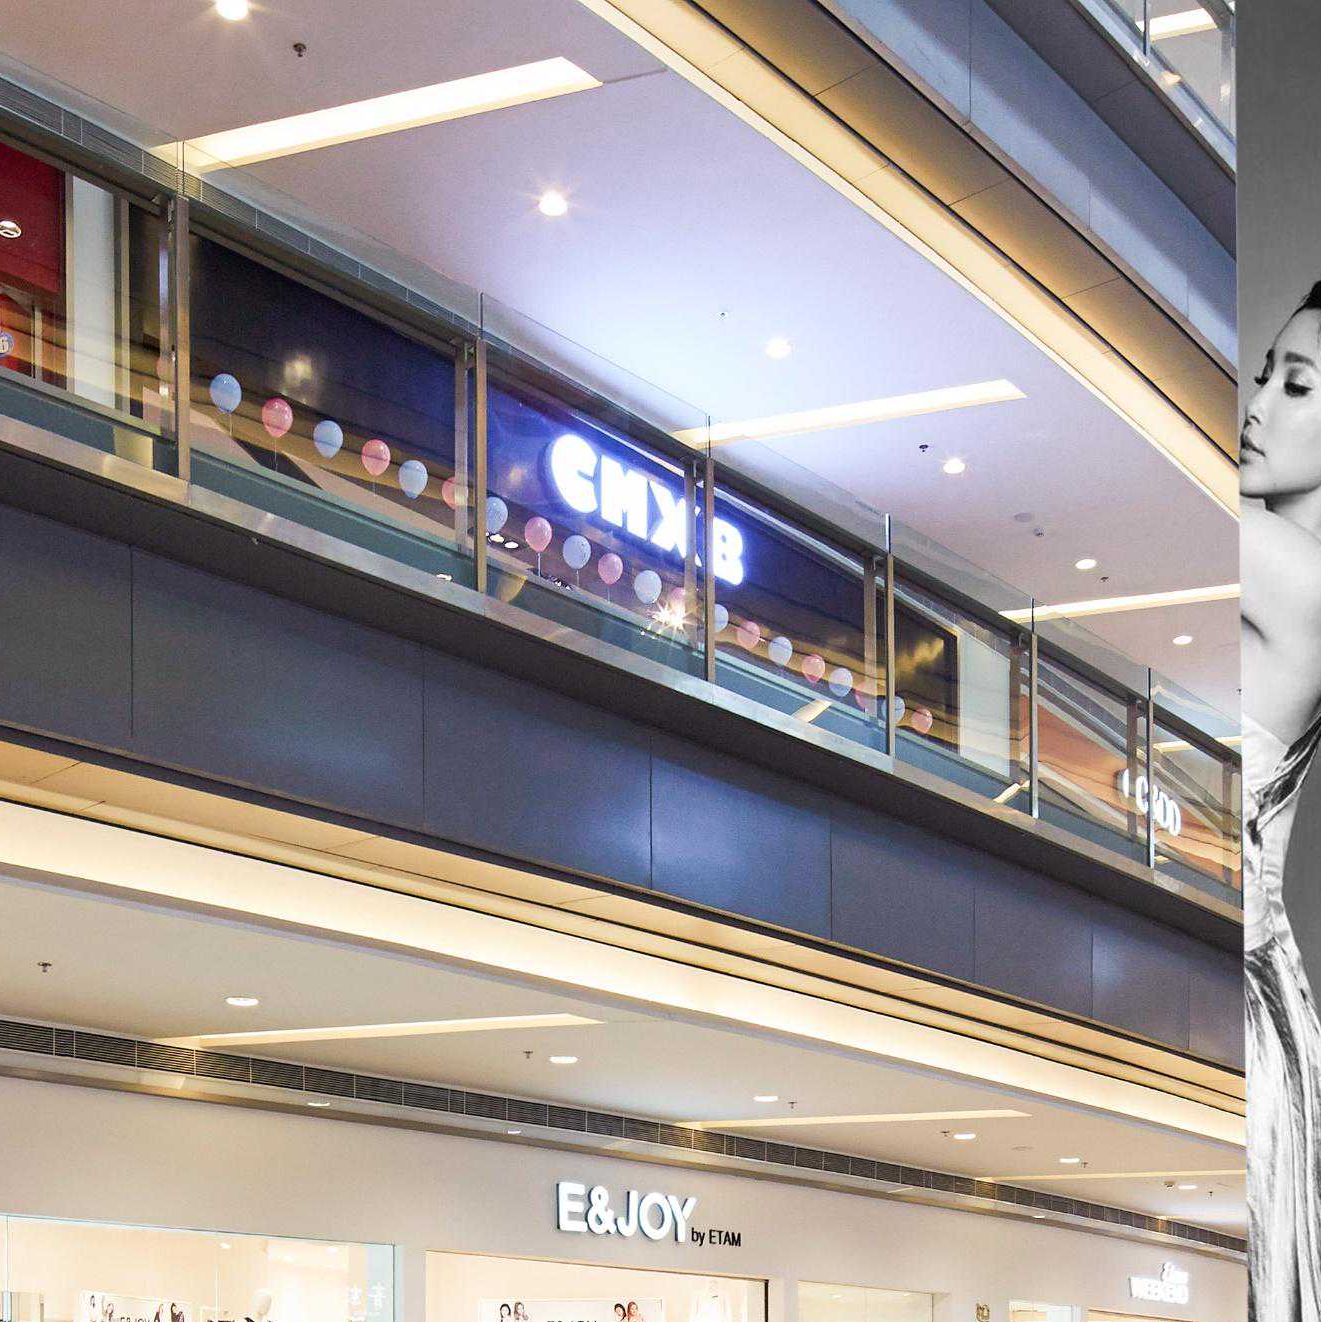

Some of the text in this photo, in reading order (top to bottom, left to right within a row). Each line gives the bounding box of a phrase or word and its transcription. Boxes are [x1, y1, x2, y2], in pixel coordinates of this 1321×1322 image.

[557, 1181, 742, 1247] E&JOY by ETAM
